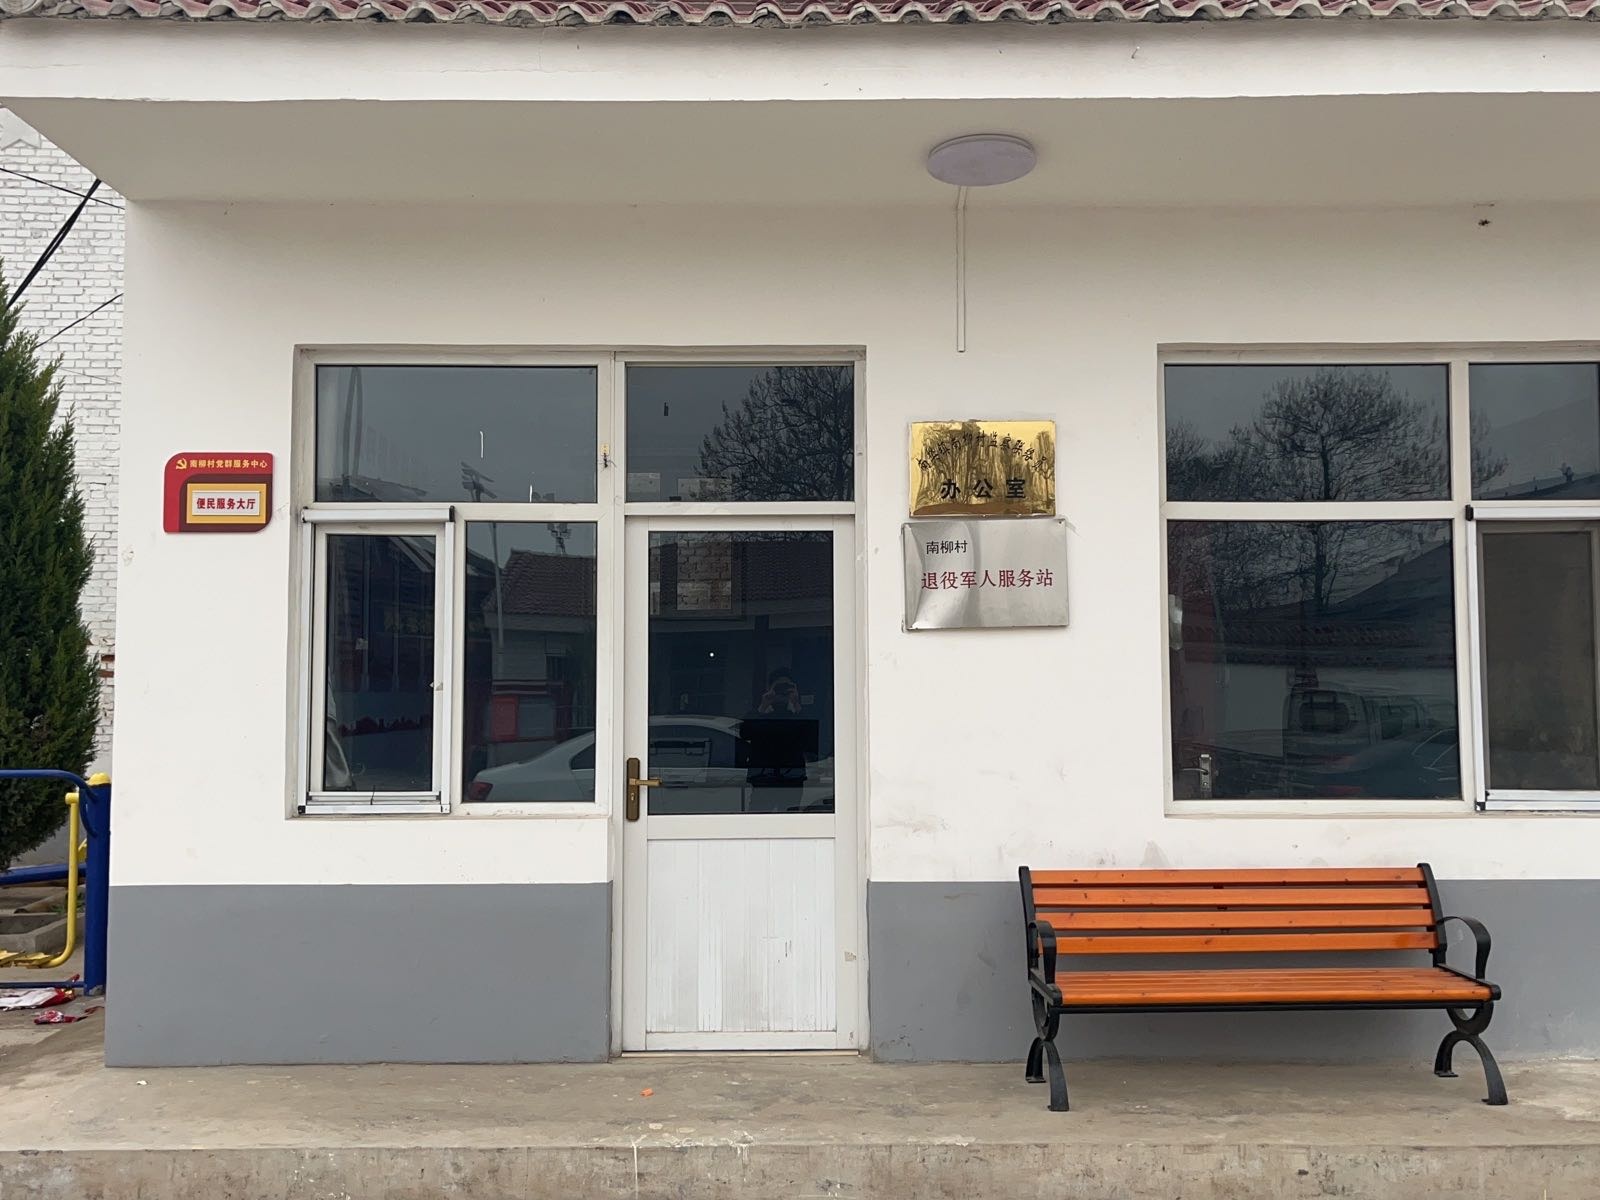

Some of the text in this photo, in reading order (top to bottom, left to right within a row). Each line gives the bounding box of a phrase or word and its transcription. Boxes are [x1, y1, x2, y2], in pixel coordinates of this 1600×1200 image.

[189, 459, 268, 469] 南柳村党群服务中心
[940, 477, 1026, 499] 办公室
[196, 497, 256, 510] 便民服务大厅
[926, 539, 968, 555] 南柳村
[921, 568, 1054, 590] 退役军人服务站
